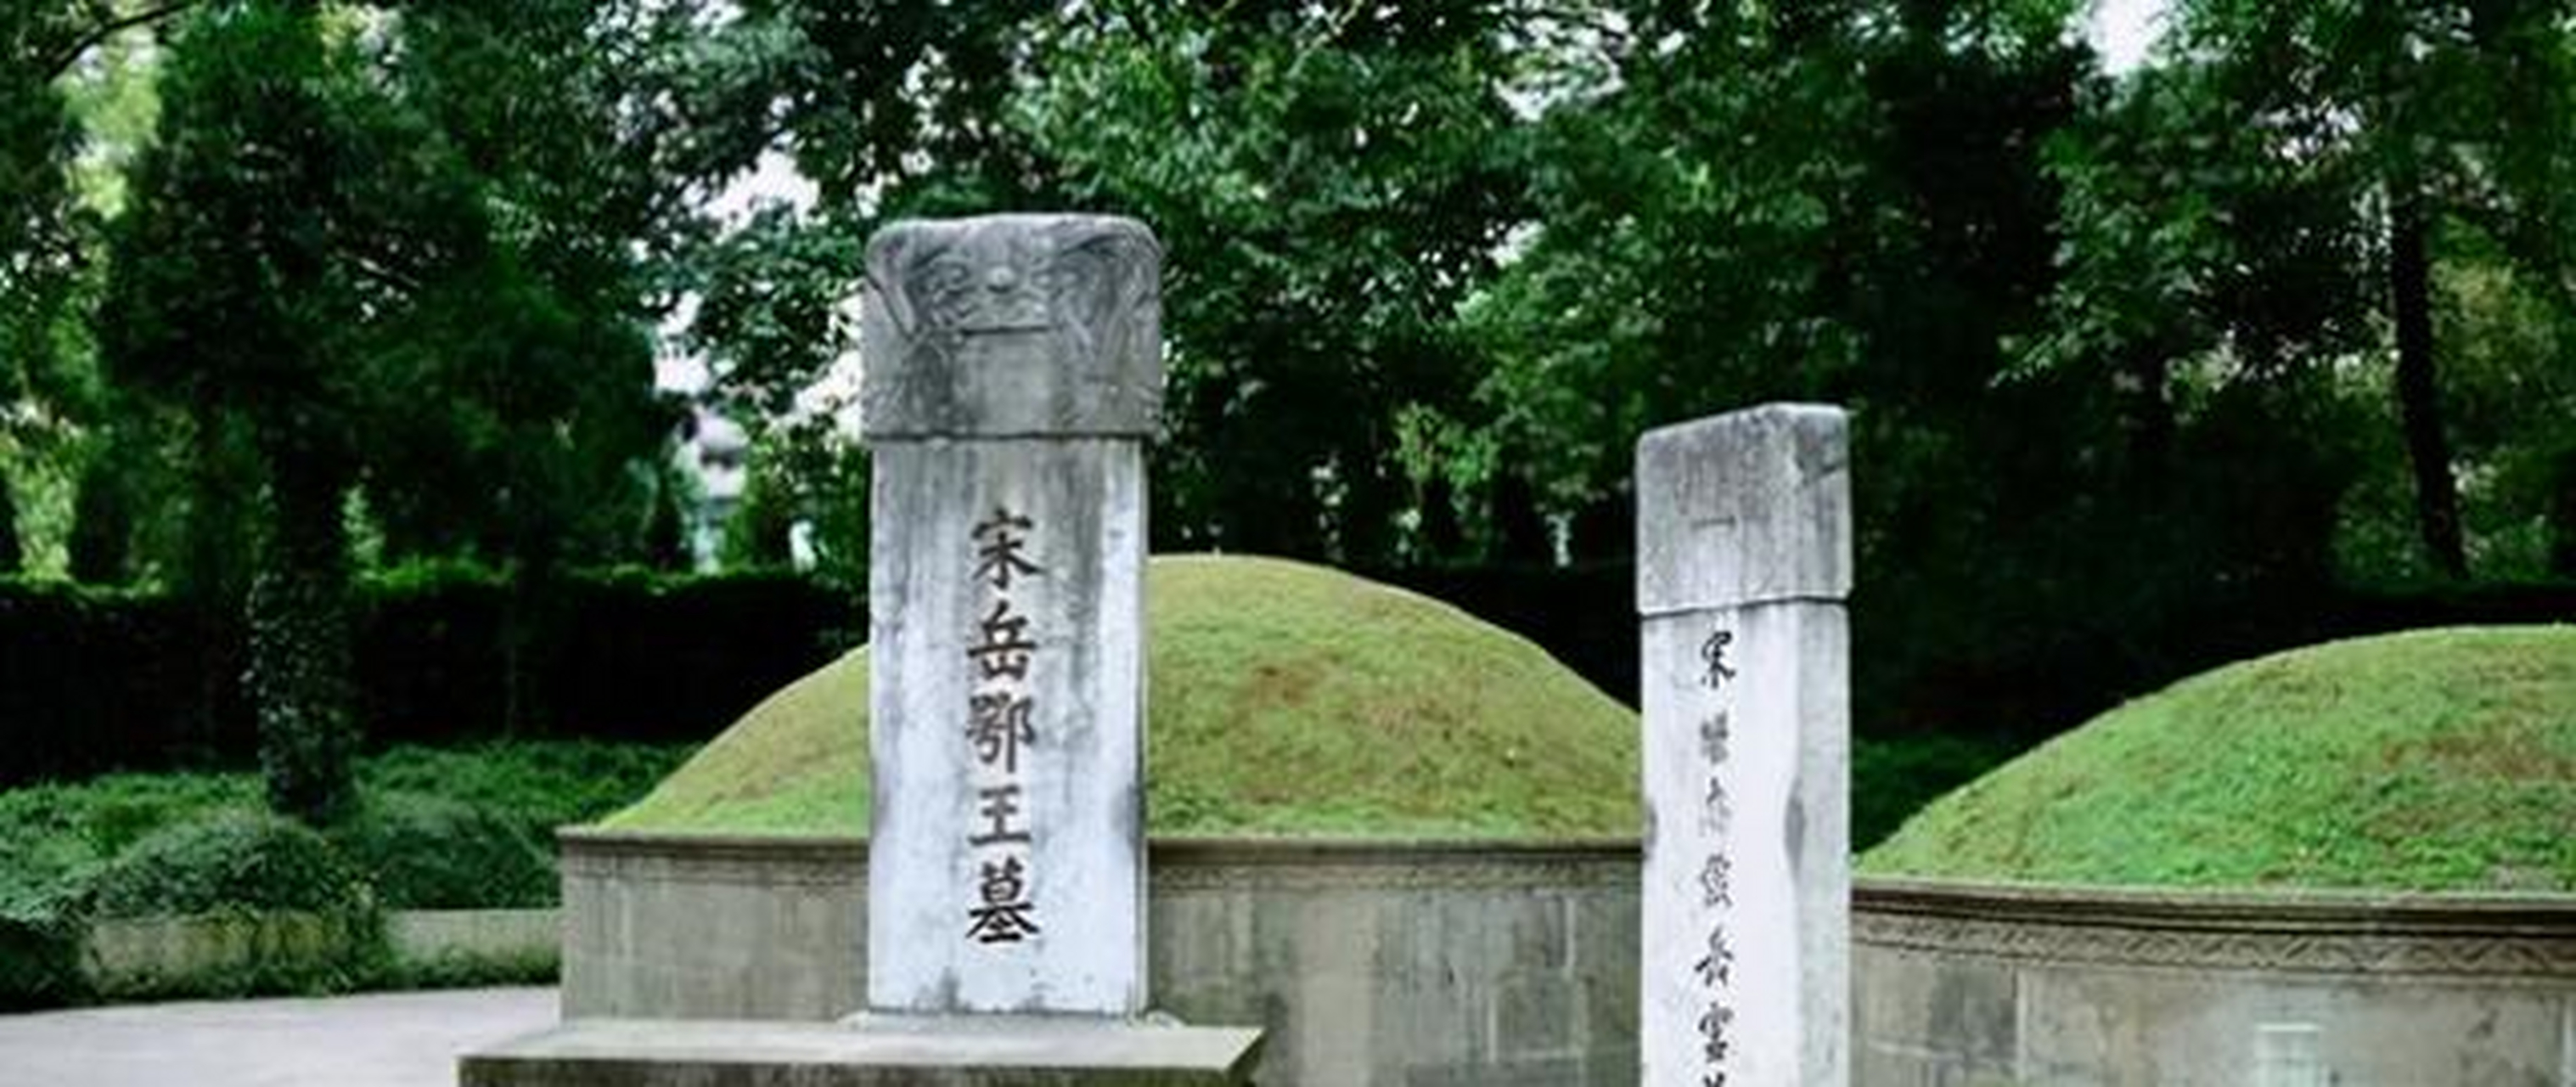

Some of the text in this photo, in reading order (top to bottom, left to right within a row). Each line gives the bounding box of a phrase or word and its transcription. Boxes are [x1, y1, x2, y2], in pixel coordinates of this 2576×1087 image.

[965, 509, 1040, 943] 宋岳鄂王墓
